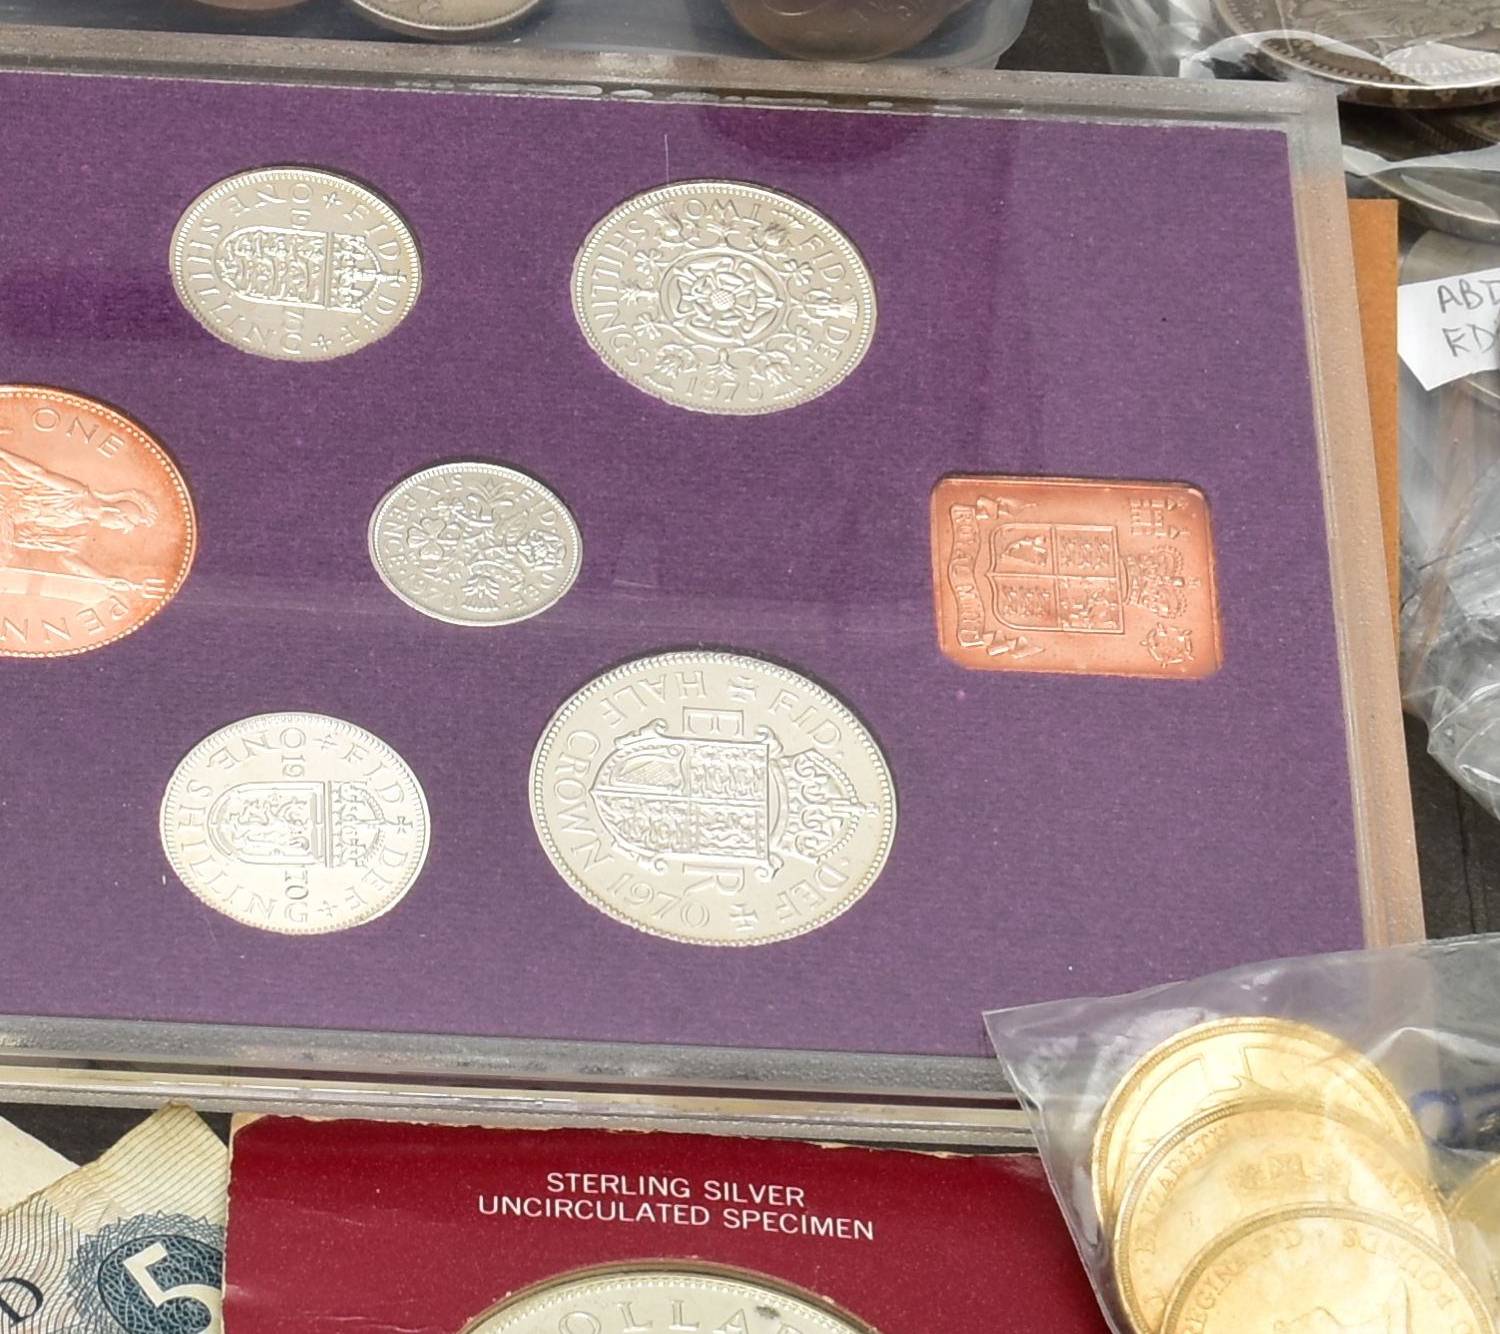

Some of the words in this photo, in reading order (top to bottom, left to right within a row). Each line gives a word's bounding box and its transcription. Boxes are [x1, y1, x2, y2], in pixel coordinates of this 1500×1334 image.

[684, 197, 763, 224] TWO
[32, 408, 126, 459] ONE
[597, 670, 710, 724] HALF
[206, 727, 308, 772] ONE
[551, 728, 613, 875] CROWN
[178, 777, 311, 927] SHILLING
[606, 871, 712, 929] 1970
[546, 1172, 694, 1201] STERLING
[703, 1179, 806, 1208] SILVER
[478, 1193, 712, 1227] UNCIRCULATED
[721, 1209, 874, 1242] SPECIMEN
